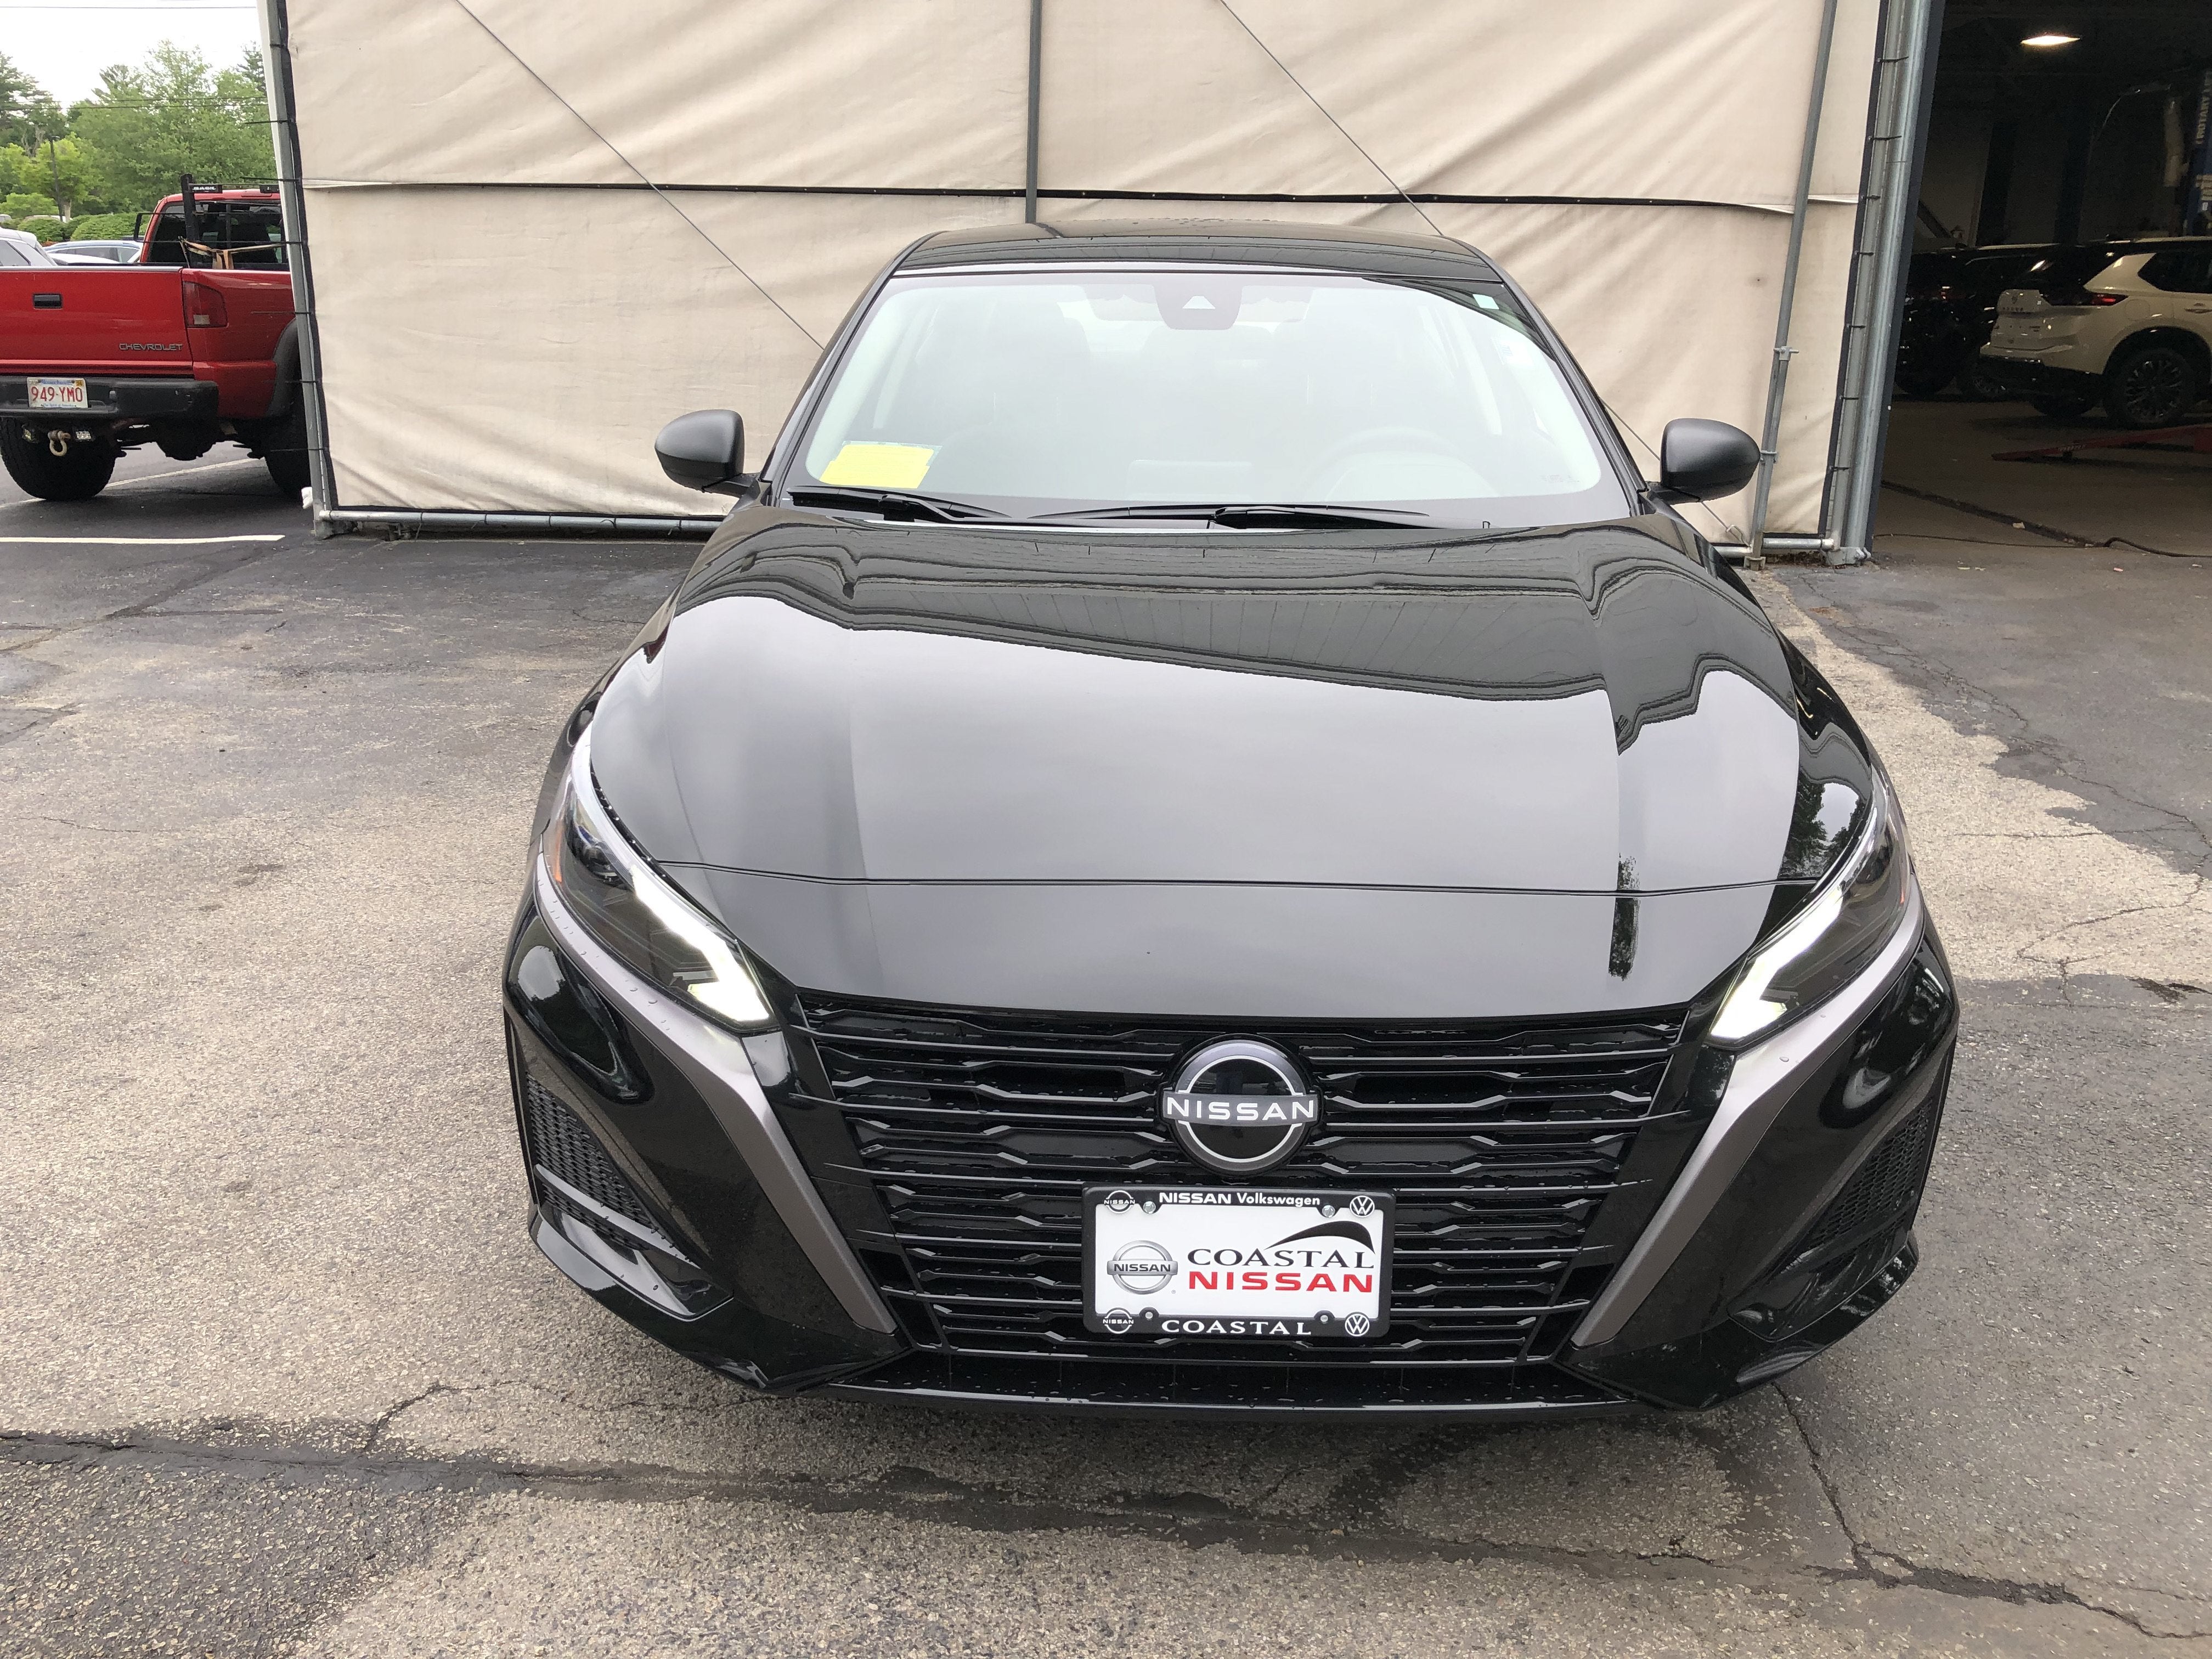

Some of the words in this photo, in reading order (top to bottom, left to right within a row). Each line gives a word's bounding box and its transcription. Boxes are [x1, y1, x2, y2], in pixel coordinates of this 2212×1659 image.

[1167, 1097, 1314, 1121] NISSAN
[1159, 1192, 1231, 1204] NISSAN
[1237, 1193, 1320, 1207] Volkswagen
[1114, 1263, 1171, 1272] NISSAN
[1187, 1248, 1374, 1269] COASTAL
[1189, 1271, 1373, 1293] NISSAN
[1161, 1319, 1312, 1335] COASTAL
